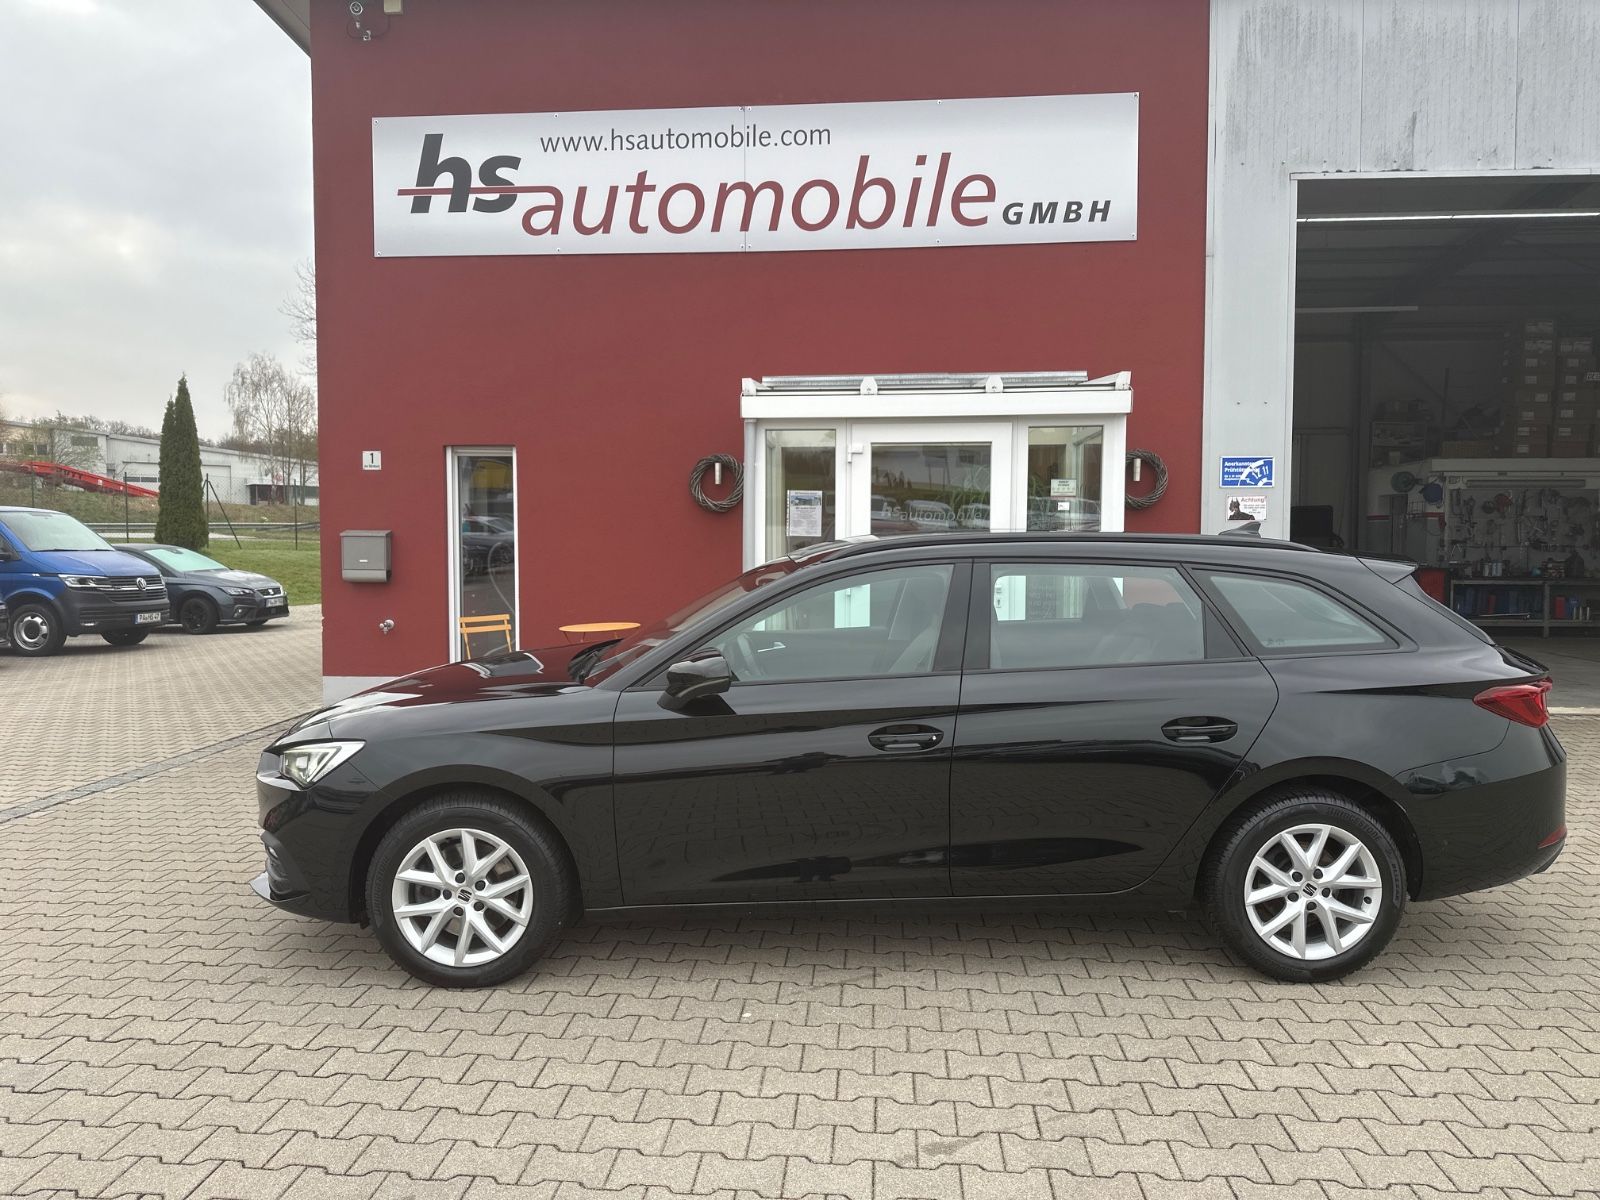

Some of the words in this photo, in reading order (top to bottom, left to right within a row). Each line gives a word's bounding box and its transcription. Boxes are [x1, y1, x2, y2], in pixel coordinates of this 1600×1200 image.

[540, 124, 831, 153] www.hsautomobile.com
[410, 133, 522, 214] hs
[521, 152, 997, 237] automobile
[1002, 200, 1111, 226] GMBH
